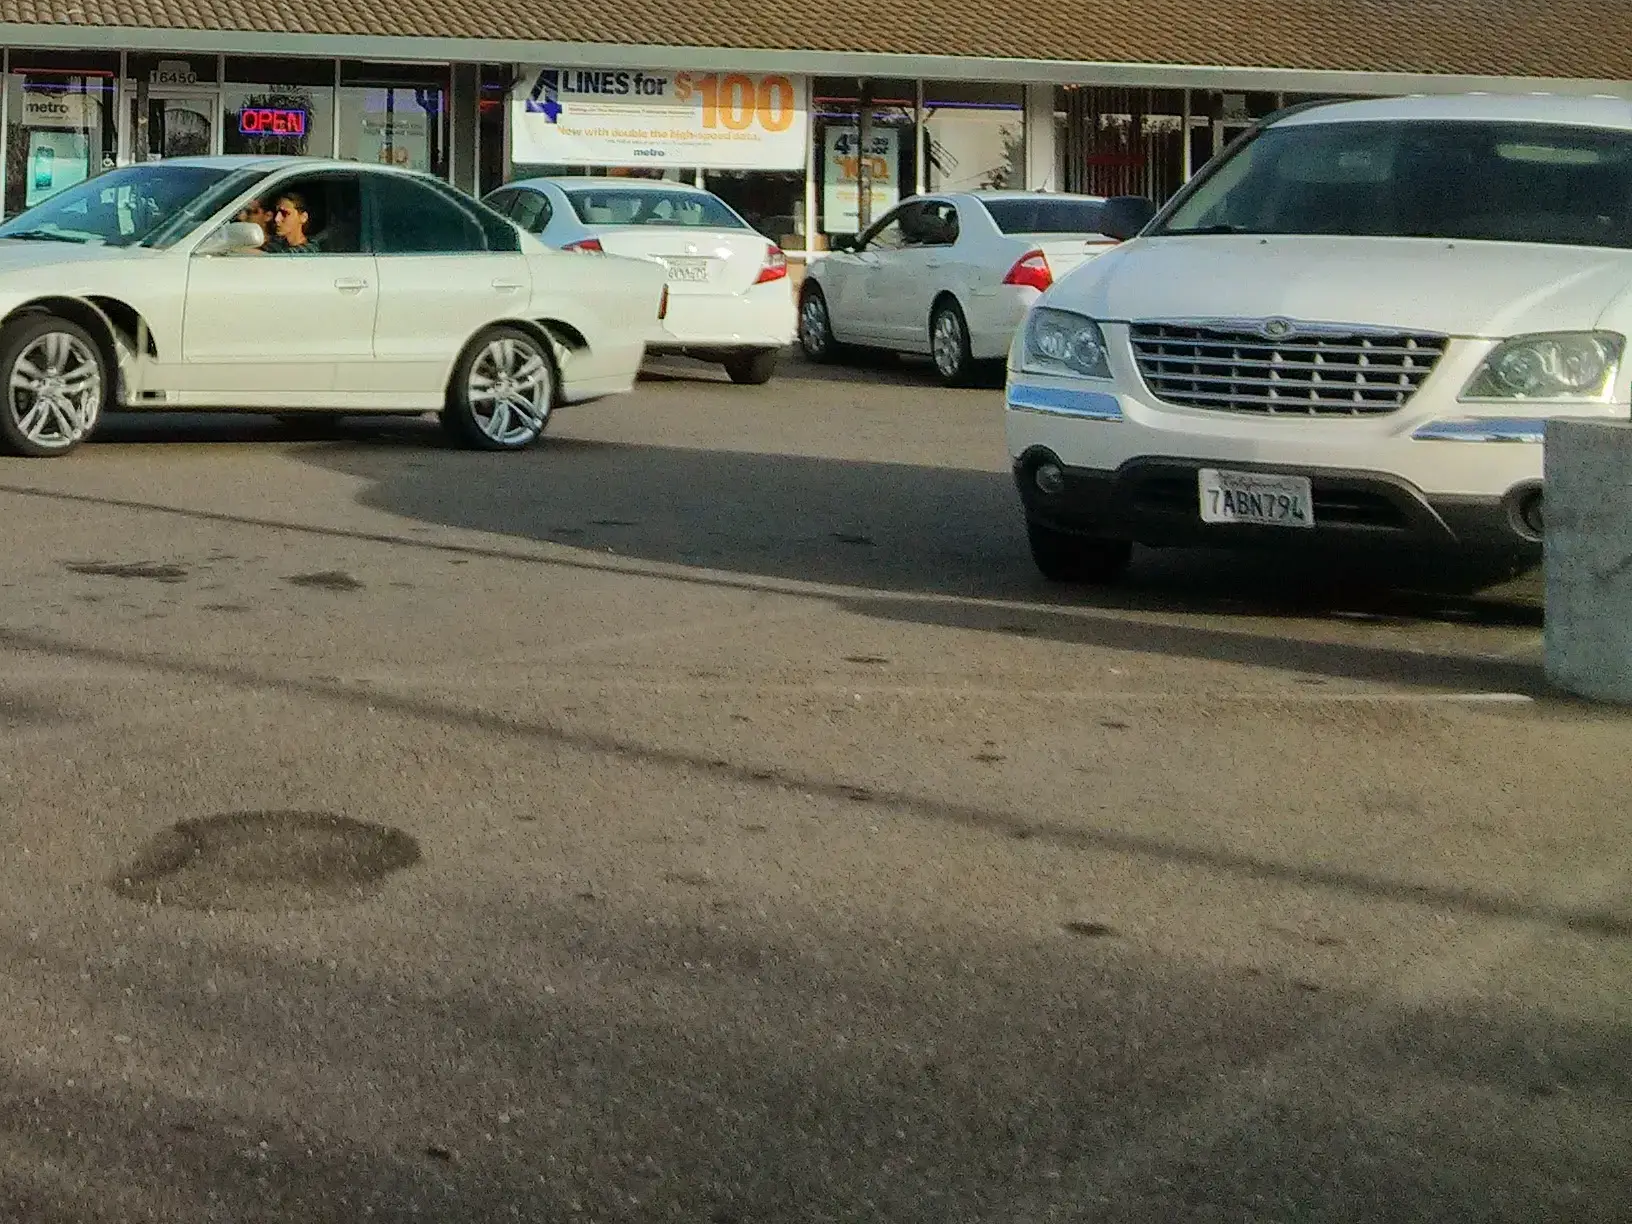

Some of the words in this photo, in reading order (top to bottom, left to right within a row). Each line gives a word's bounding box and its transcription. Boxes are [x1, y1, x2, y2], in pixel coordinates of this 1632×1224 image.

[151, 71, 196, 84] 16450
[525, 69, 562, 124] 4
[562, 70, 629, 95] LINES
[632, 73, 668, 96] for
[673, 71, 796, 132] $100
[242, 111, 302, 132] OPEN
